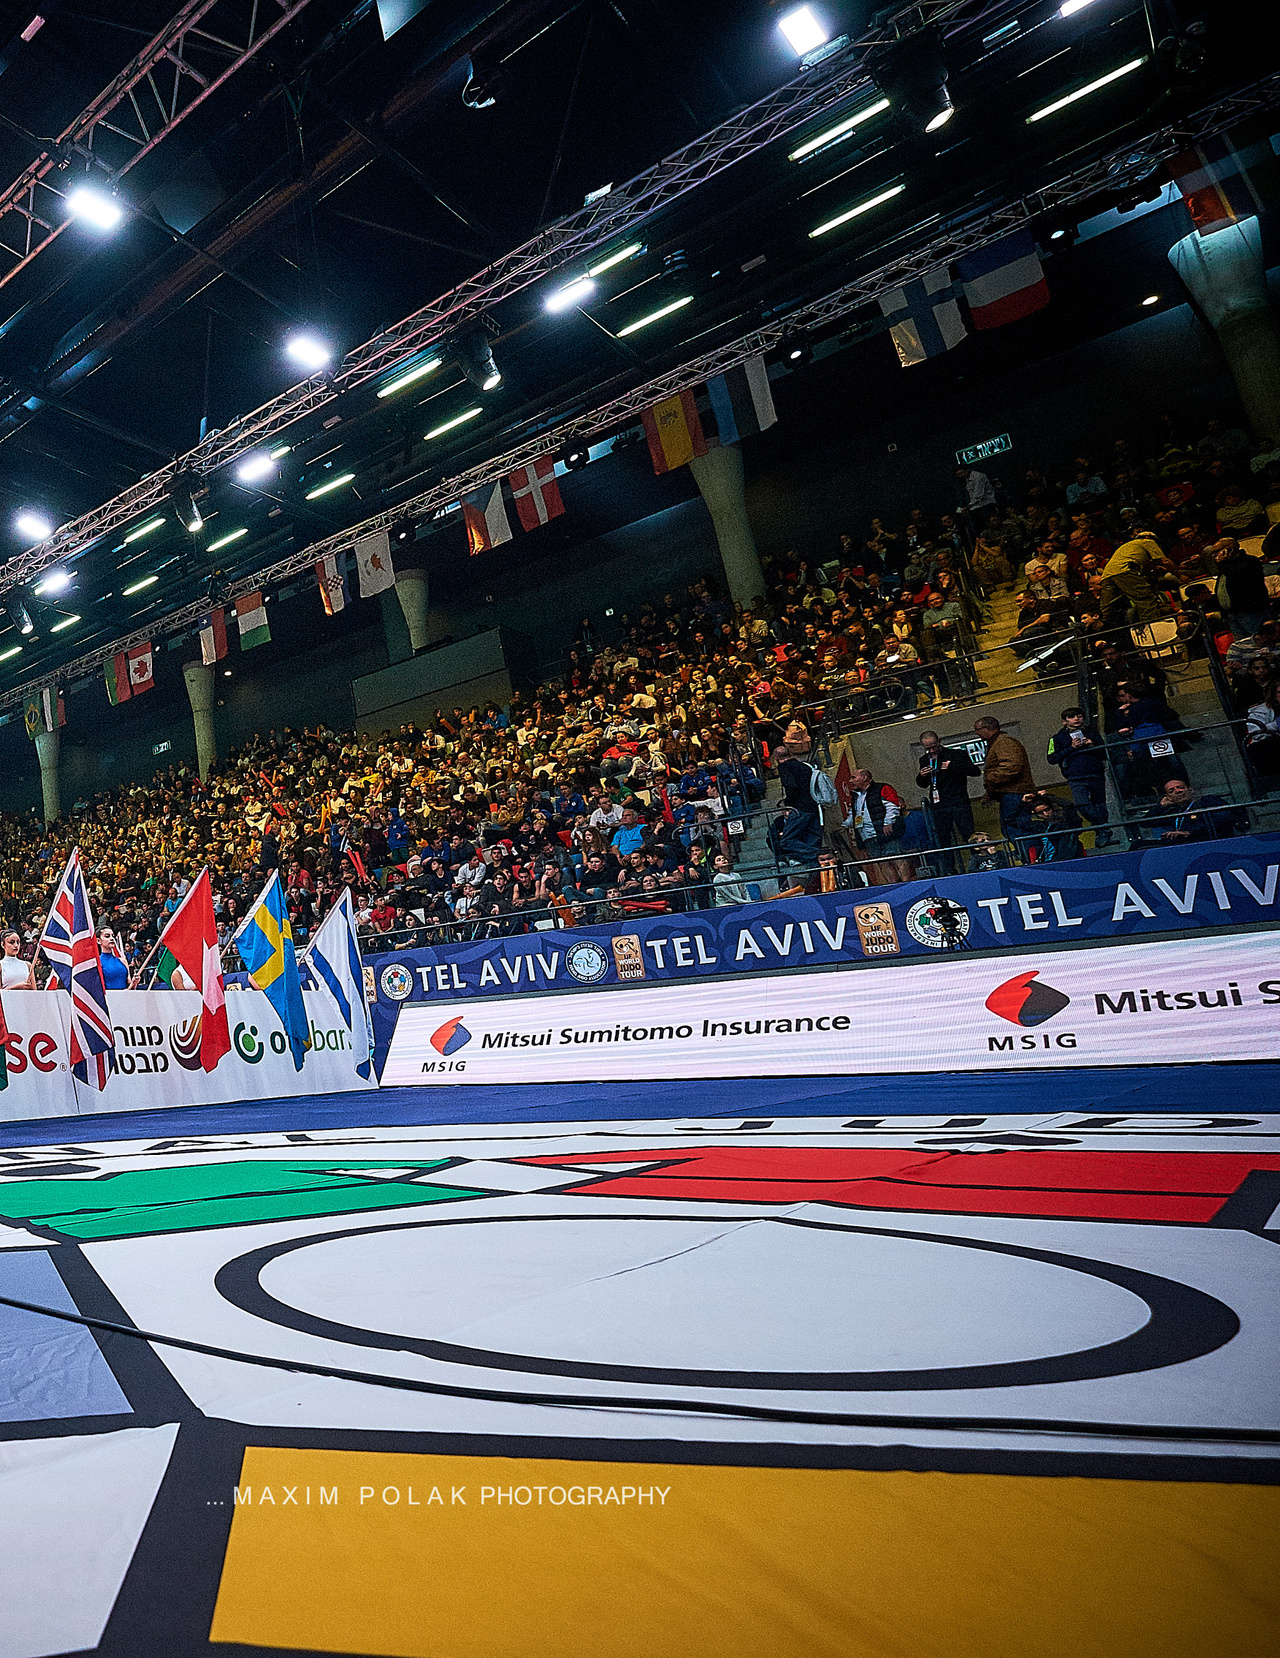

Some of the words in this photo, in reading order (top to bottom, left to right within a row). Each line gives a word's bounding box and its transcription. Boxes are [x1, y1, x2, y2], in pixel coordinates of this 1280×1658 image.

[977, 891, 1083, 933] TEL
[1111, 865, 1280, 922] AVIV
[647, 935, 718, 969] TEL
[736, 918, 847, 961] AVIV
[863, 930, 893, 938] WORLD
[865, 936, 894, 946] JUDO
[866, 944, 897, 954] TOUR
[416, 964, 467, 992] TEL
[479, 952, 559, 987] AVIV
[620, 963, 641, 972] JUDO
[620, 971, 643, 979] TOUR
[1094, 981, 1244, 1015] Mitsui
[113, 1025, 164, 1047] מנור
[482, 1028, 553, 1049] Mitsui
[560, 1024, 693, 1045] Sumitomo
[703, 1015, 852, 1038] Insurance
[988, 1033, 1078, 1052] MSIG
[421, 1061, 467, 1073] MSIG
